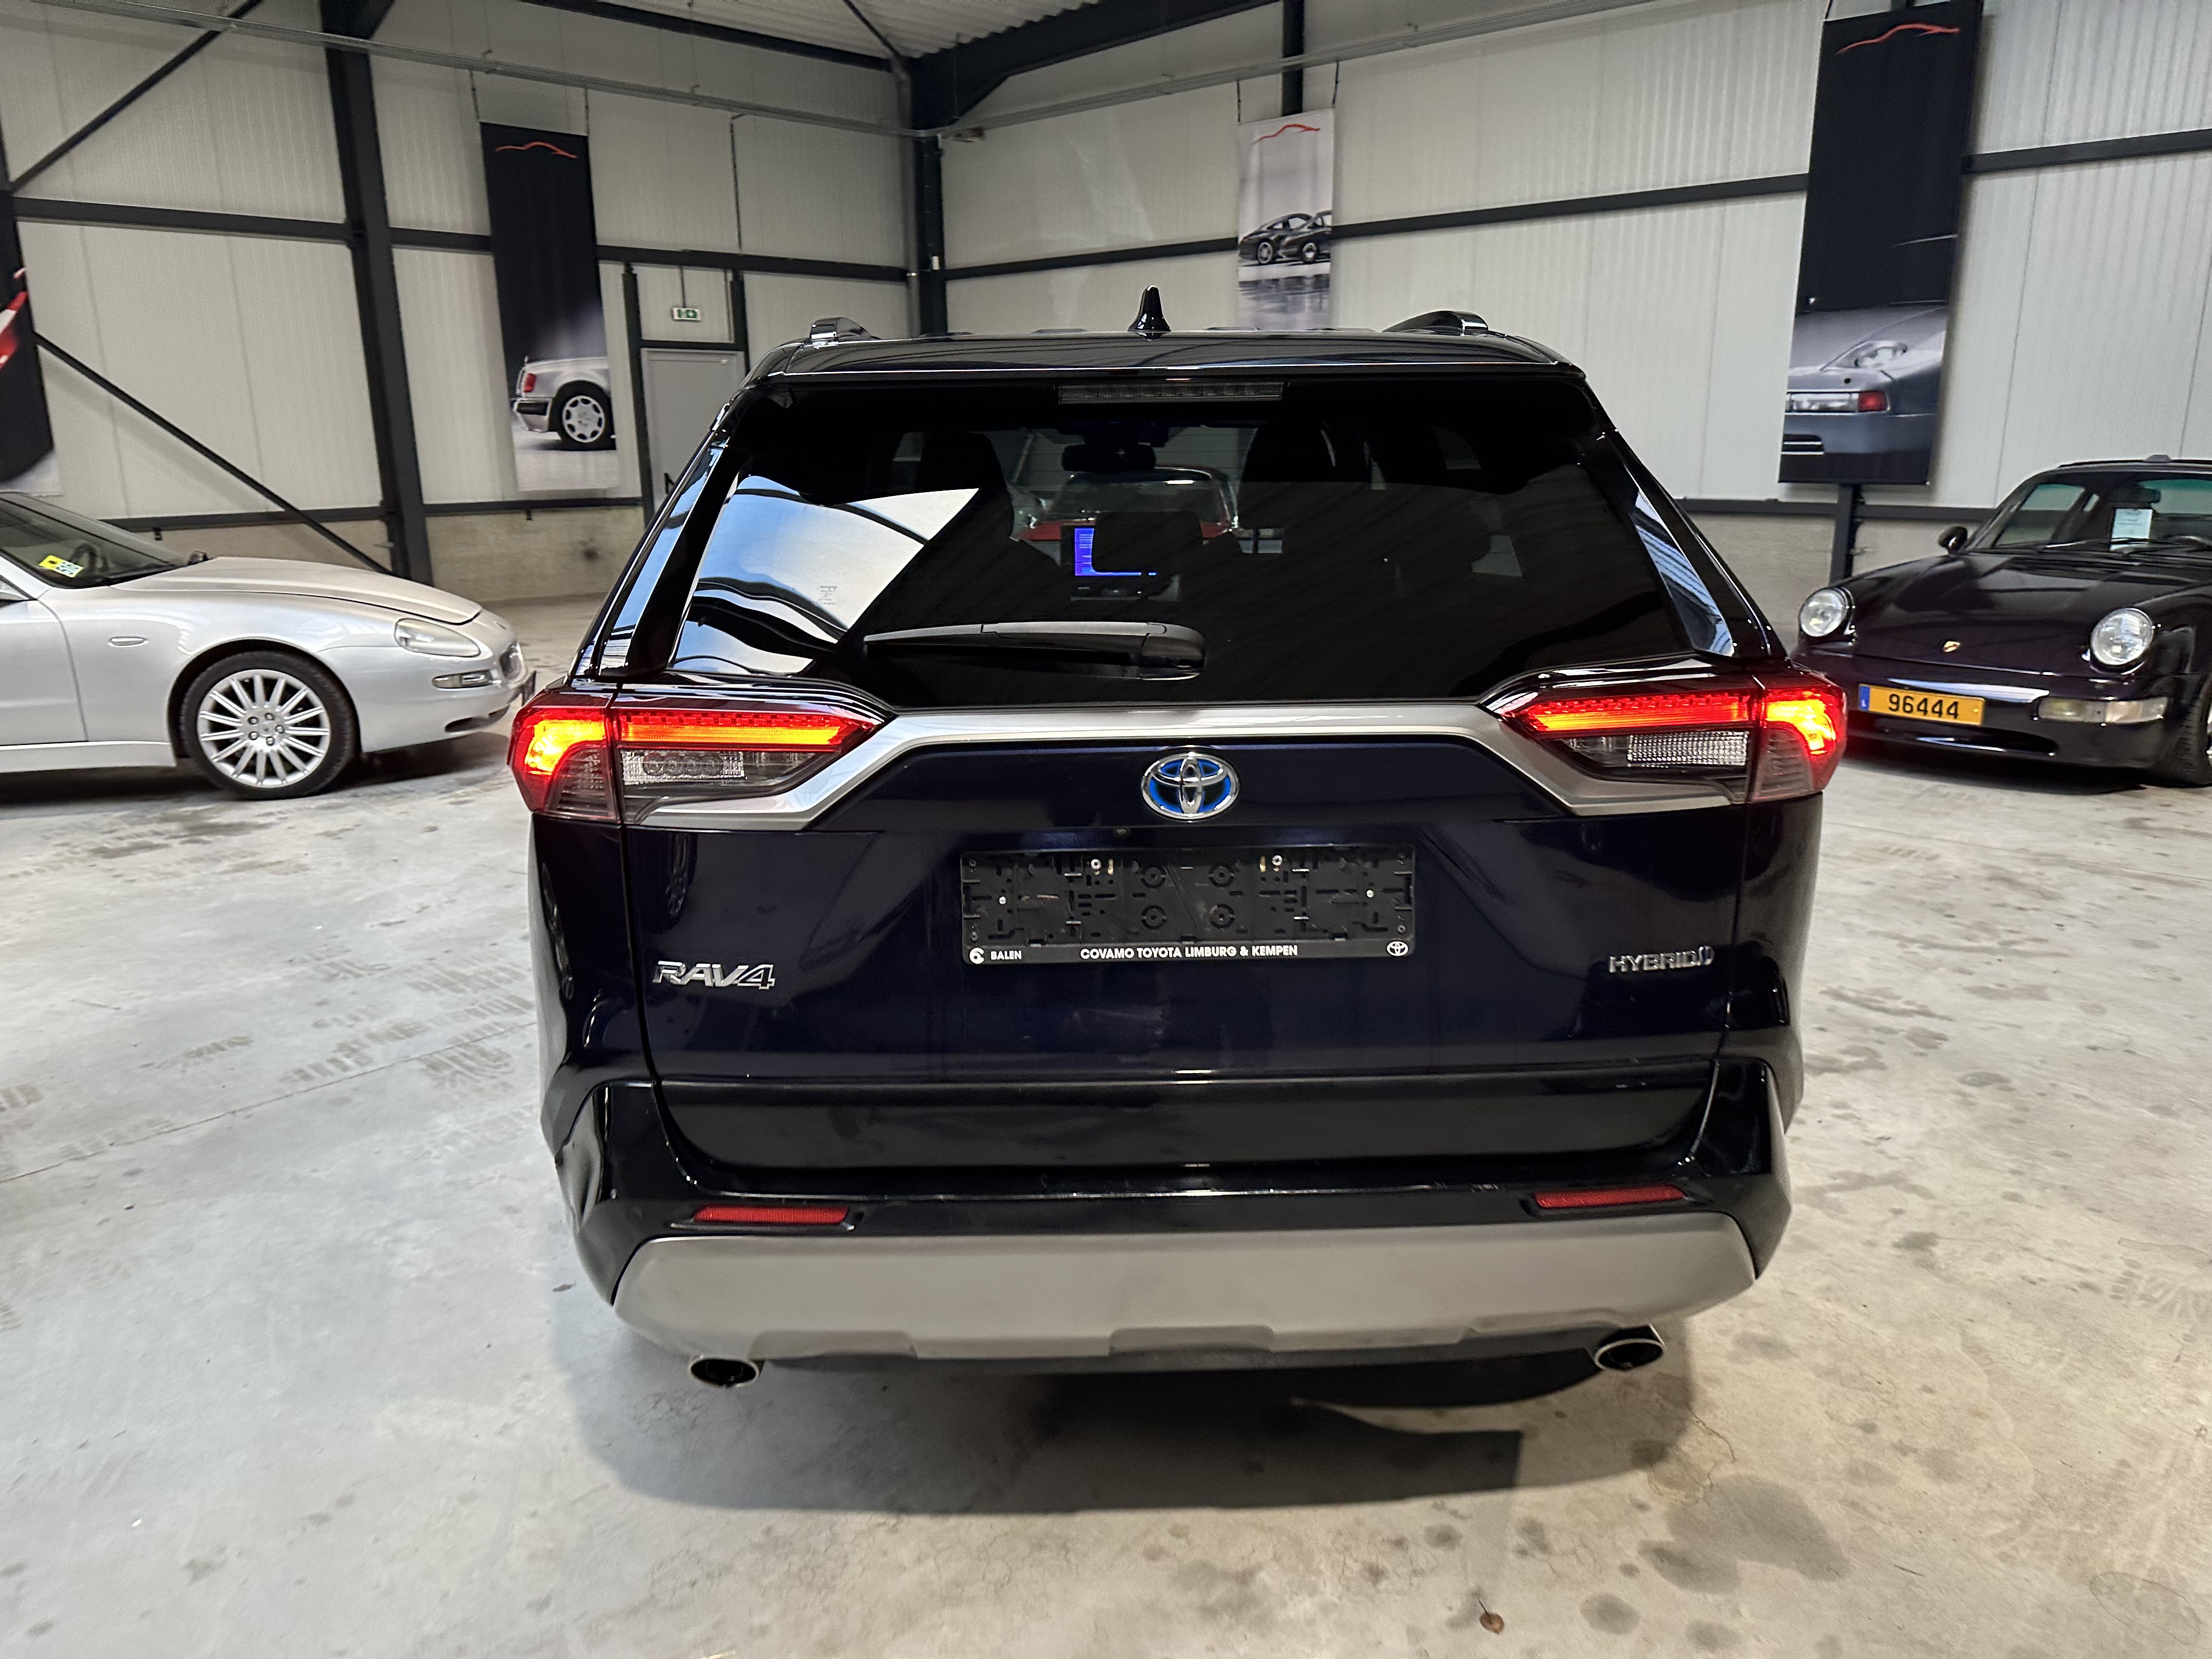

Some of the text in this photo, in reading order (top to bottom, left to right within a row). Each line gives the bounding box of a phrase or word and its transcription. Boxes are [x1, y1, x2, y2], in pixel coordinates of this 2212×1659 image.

[1888, 693, 1959, 719] 96444
[990, 950, 1022, 960] BALEN
[1080, 945, 1298, 960] COVAMO TOYOTA LIMBURG & KEMPEN
[1609, 951, 1701, 973] HYBRID
[652, 960, 776, 990] RAV4
